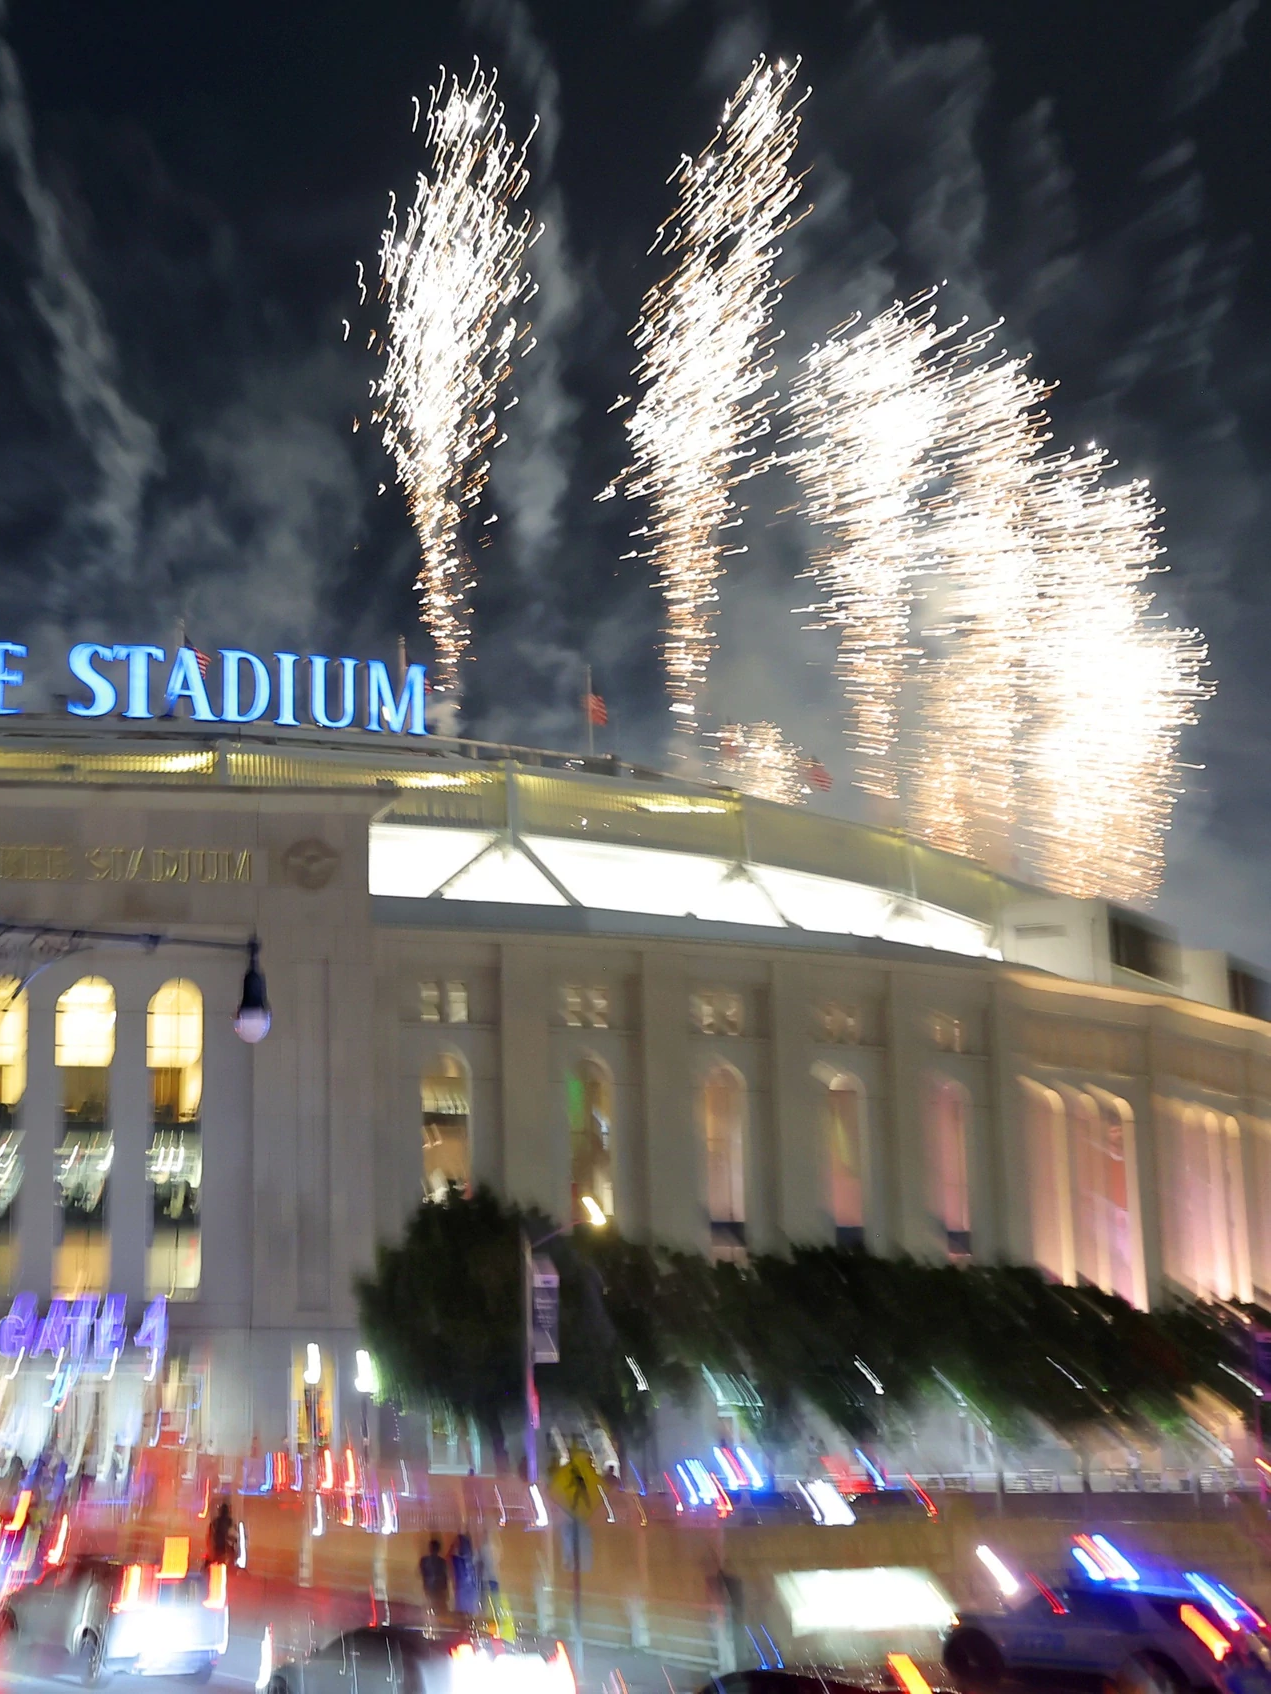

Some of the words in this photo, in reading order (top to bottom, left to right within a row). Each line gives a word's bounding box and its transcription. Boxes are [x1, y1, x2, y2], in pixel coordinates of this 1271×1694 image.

[66, 644, 428, 736] STADIUM
[84, 847, 250, 882] STADIUM
[133, 1294, 169, 1360] 4
